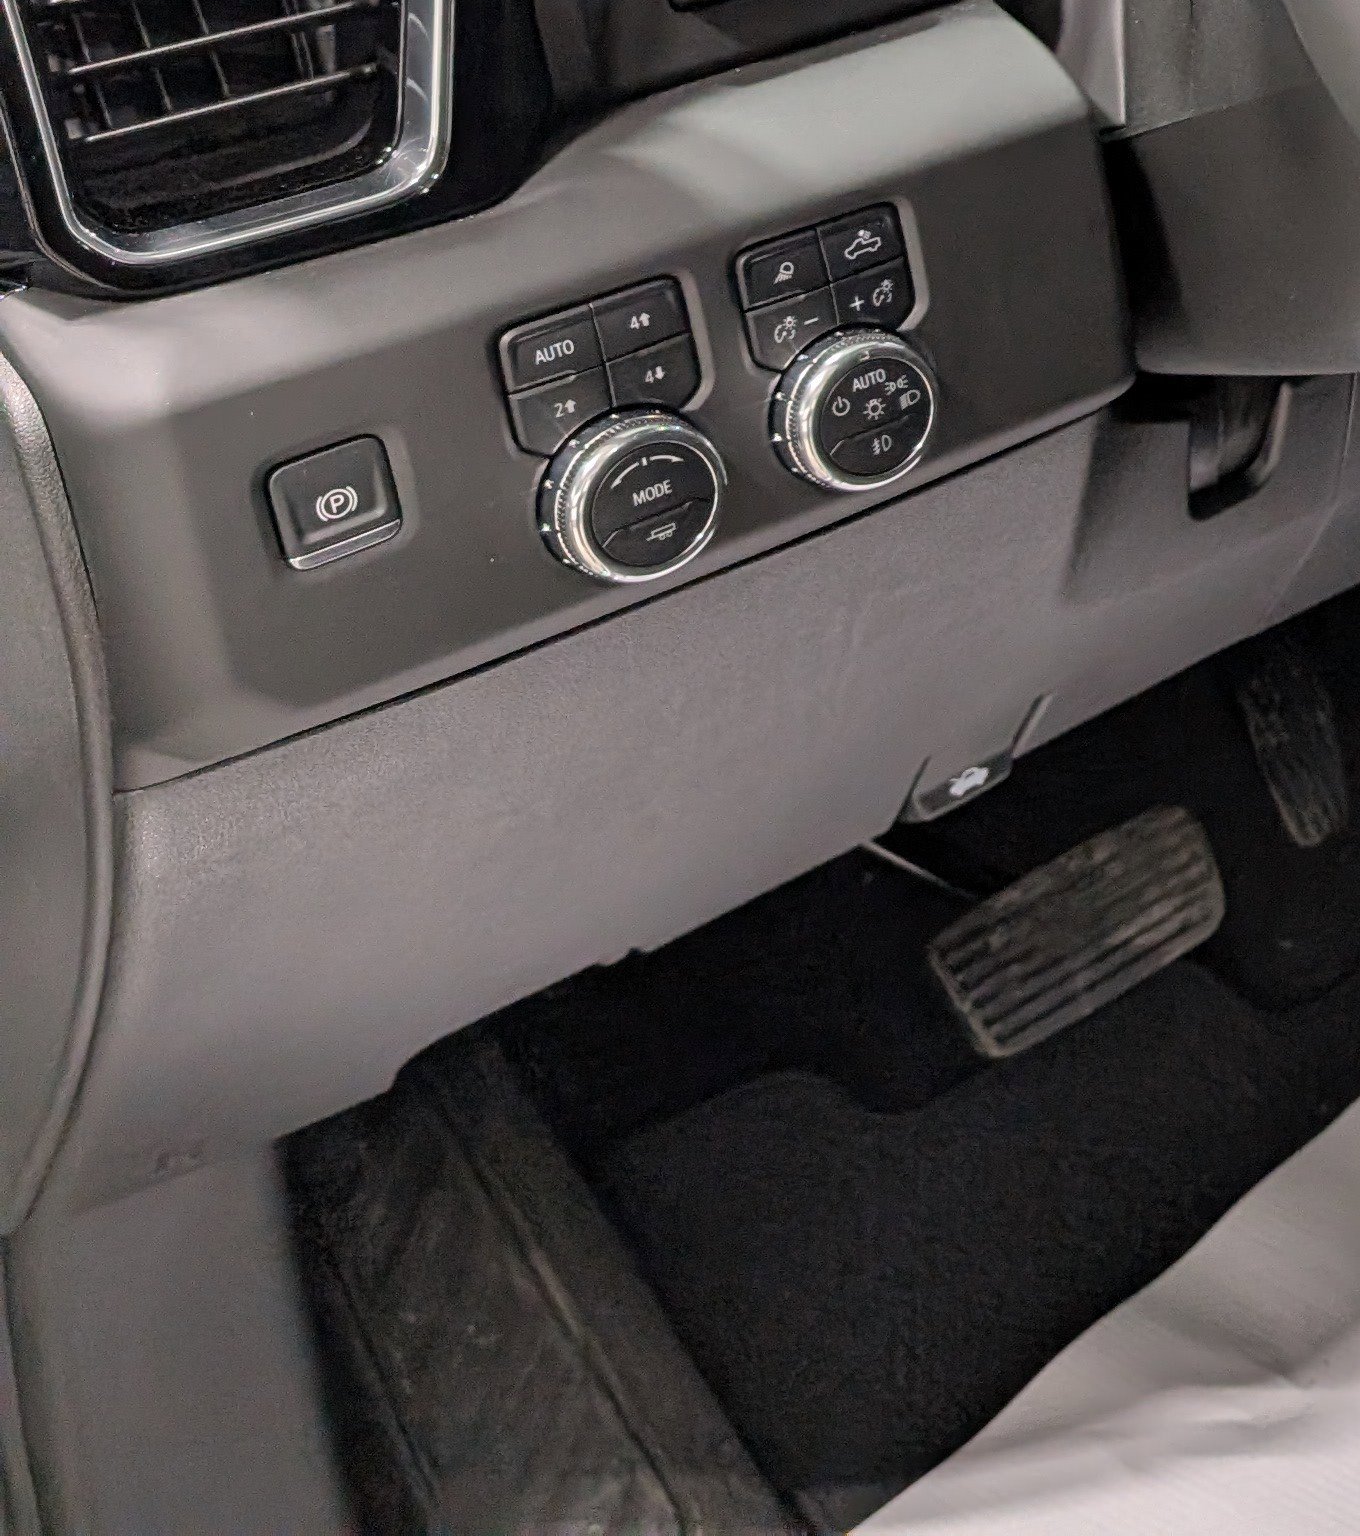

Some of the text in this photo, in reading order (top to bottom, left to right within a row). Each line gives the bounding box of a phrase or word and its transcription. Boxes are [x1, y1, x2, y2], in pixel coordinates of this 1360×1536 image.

[534, 339, 575, 364] AUTO
[852, 368, 887, 392] AUTO
[632, 479, 673, 507] MODE
